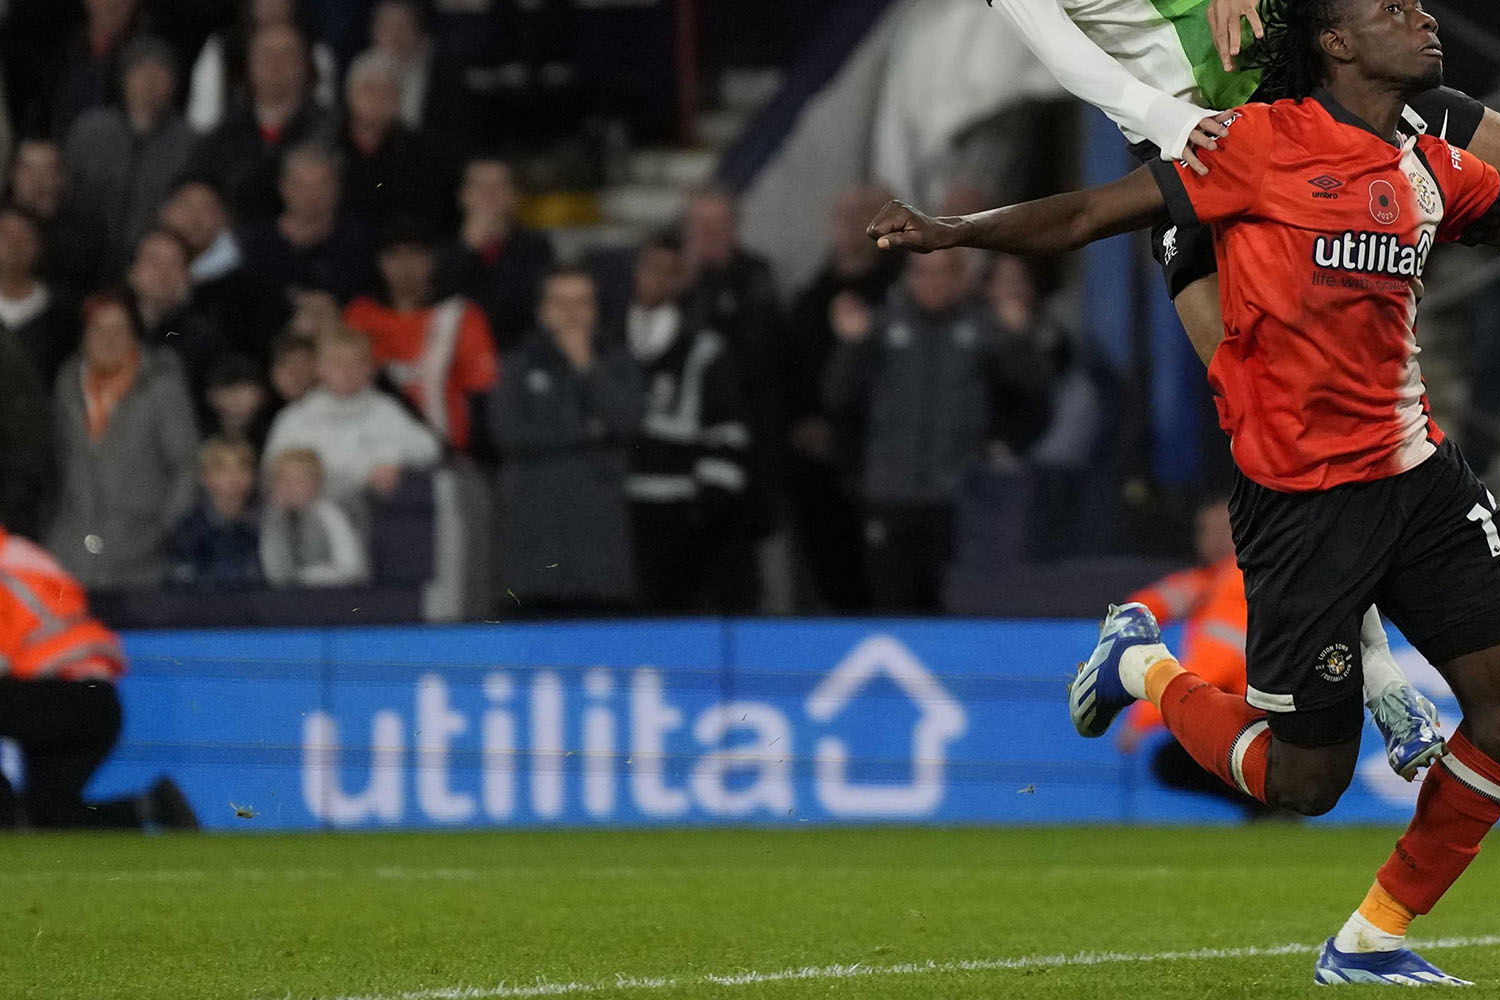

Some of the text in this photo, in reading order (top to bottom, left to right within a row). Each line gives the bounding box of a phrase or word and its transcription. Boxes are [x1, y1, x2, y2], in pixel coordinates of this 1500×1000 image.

[1311, 191, 1338, 200] umbro
[1377, 210, 1395, 220] 2023
[1314, 230, 1416, 277] utilita
[1312, 270, 1337, 286] life
[302, 664, 795, 825] utilita
